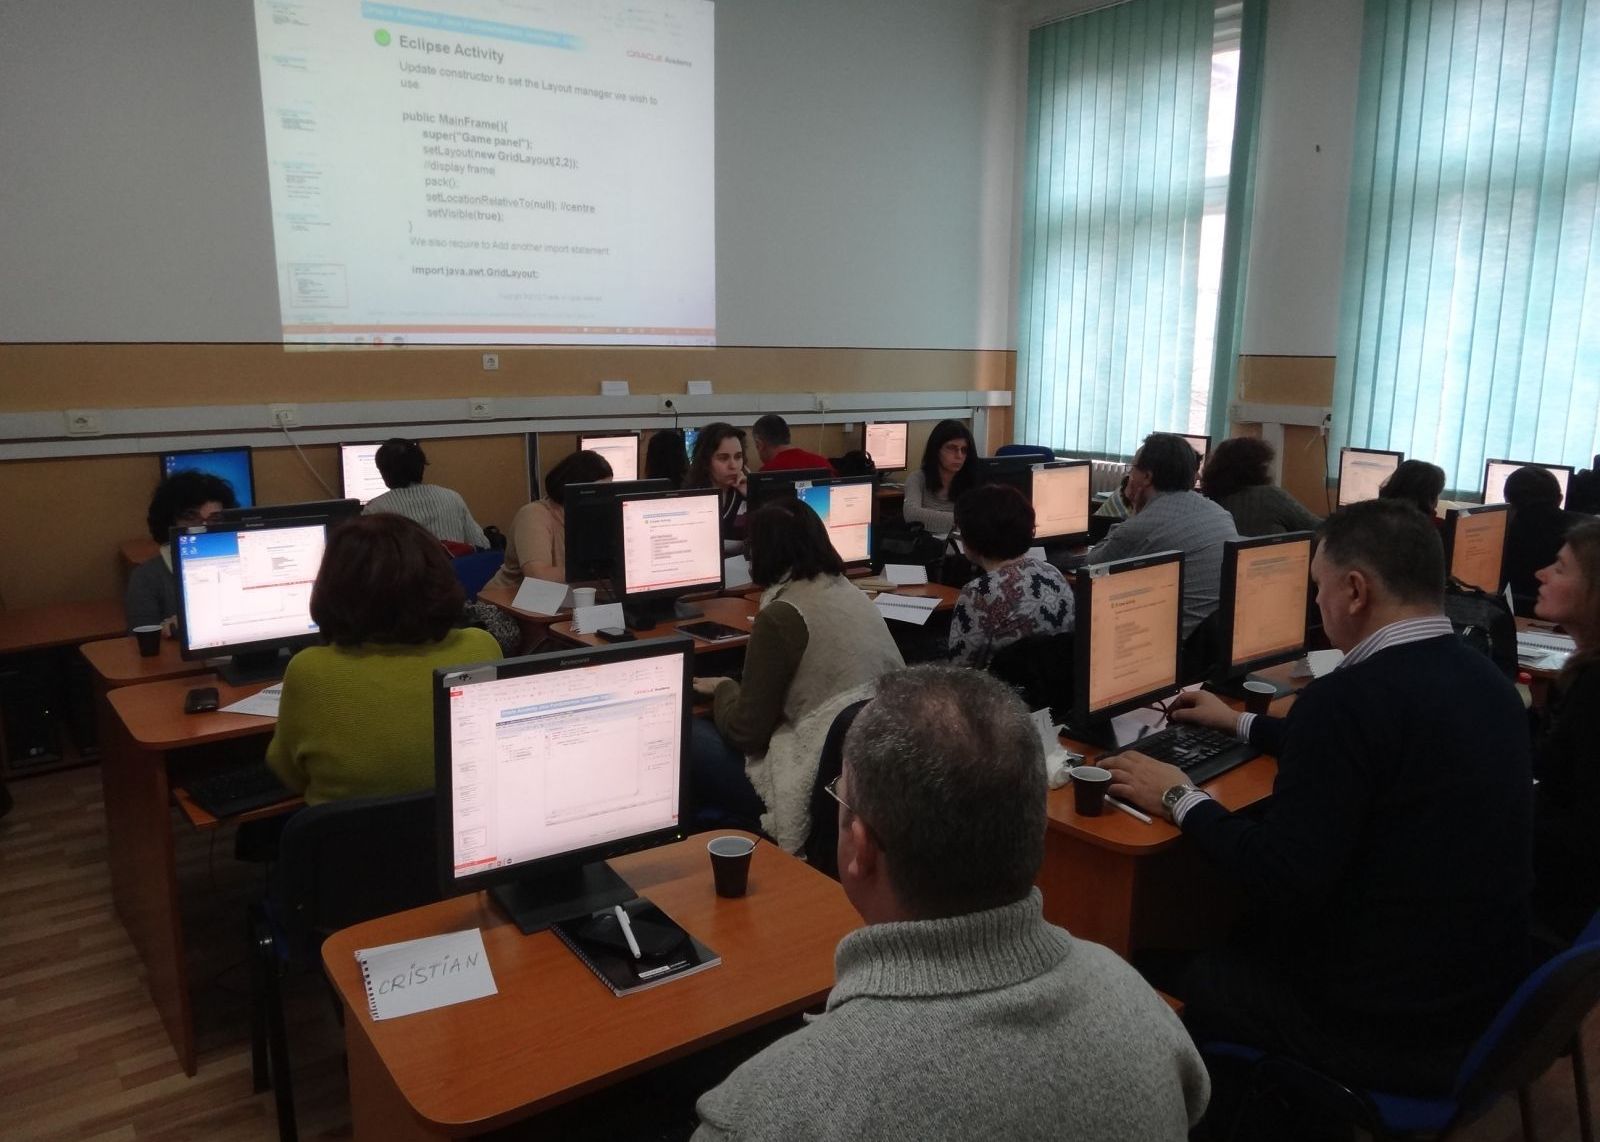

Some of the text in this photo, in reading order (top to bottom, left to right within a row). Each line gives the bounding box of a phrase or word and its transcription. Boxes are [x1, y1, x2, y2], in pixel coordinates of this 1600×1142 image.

[399, 35, 504, 64] Eclipse Activity
[399, 61, 437, 76] Update
[439, 67, 493, 82] constructor
[496, 73, 505, 84] to
[508, 76, 522, 87] set
[524, 78, 539, 89] the
[541, 79, 572, 97] Layout
[574, 86, 613, 100] manager
[650, 95, 658, 105] to
[402, 111, 435, 123] public
[409, 237, 427, 248] We
[449, 238, 479, 251] require
[481, 239, 491, 249] to
[492, 240, 509, 251] Add
[412, 265, 445, 277] import
